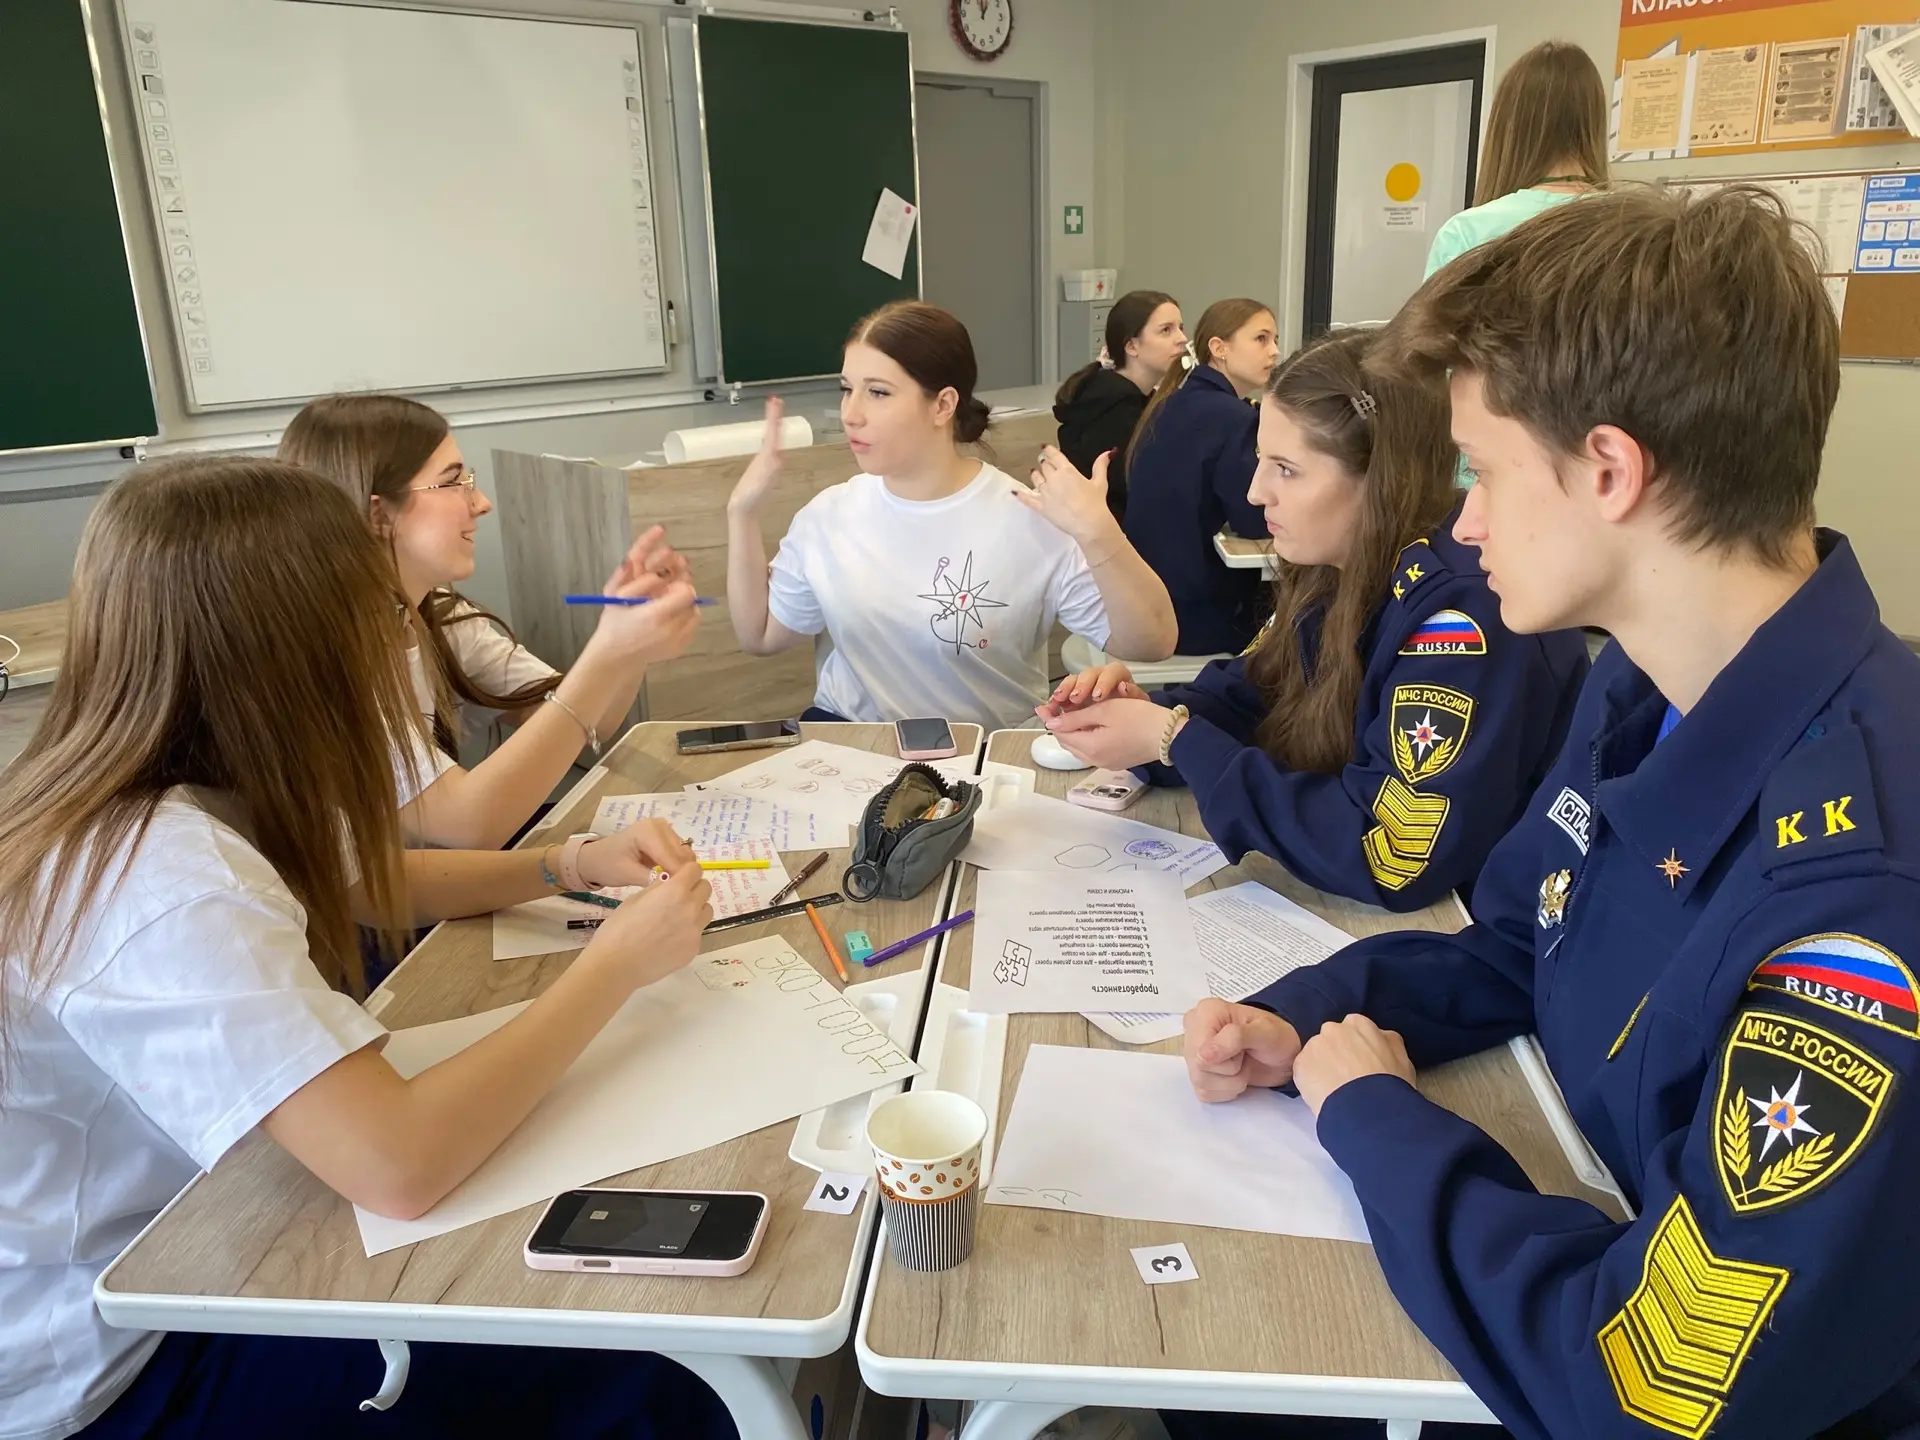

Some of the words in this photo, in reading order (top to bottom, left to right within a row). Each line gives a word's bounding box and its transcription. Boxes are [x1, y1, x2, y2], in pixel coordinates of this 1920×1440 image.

[1416, 641, 1467, 653] RUSSIA
[1398, 689, 1421, 701] МЧС
[1422, 689, 1470, 713] РОССИИ
[1560, 800, 1591, 849] СПАС
[1052, 933, 1074, 941] работает
[1091, 983, 1159, 995] Проработанность
[1784, 975, 1884, 1021] RUSSIA
[1743, 1018, 1788, 1047] МЧС
[1789, 1031, 1883, 1095] РОССИИ
[819, 1183, 850, 1201] 2
[1150, 1255, 1183, 1274] 3
